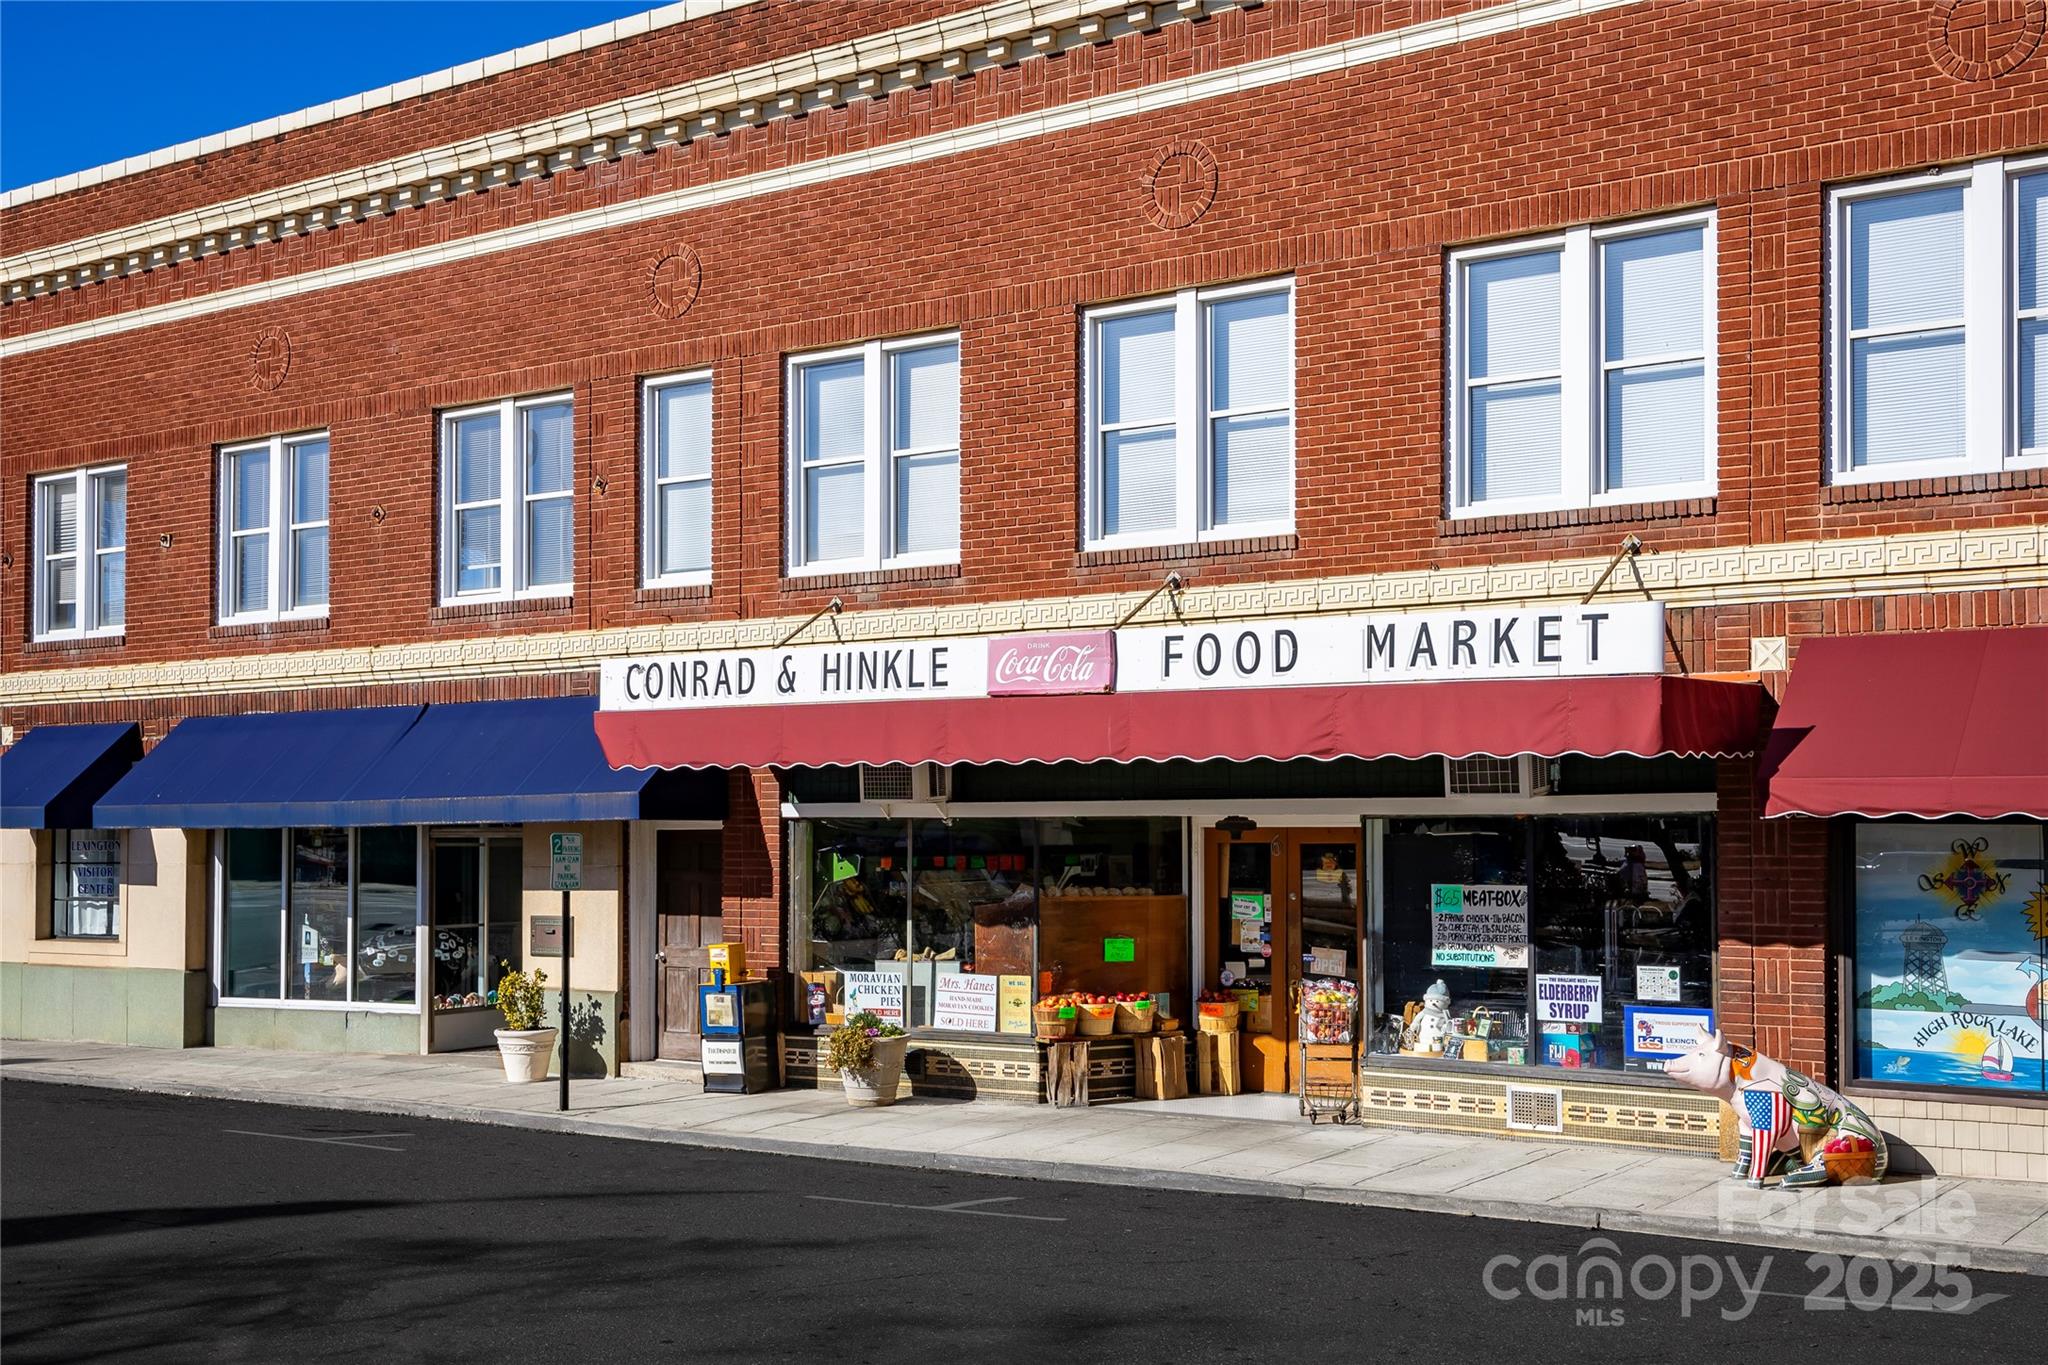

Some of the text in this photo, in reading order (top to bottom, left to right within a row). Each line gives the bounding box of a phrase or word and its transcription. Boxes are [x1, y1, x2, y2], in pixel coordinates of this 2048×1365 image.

[1162, 612, 1610, 681] FOOD MARKET
[625, 646, 950, 702] CONRAD & HINKLE
[71, 840, 121, 852] LEXINGTON
[554, 838, 561, 853] 2
[77, 867, 114, 878] VISITOR
[78, 883, 113, 894] CENTER
[1434, 887, 1521, 908] $65 MEAT-BOX
[1502, 913, 1526, 924] BACON
[1491, 924, 1522, 934] SAUSAGE
[1436, 952, 1495, 962] NO SUBSTITUTIONS
[1314, 958, 1344, 974] OPEN
[850, 972, 900, 983] MORAVIAN
[858, 985, 900, 995] CHICKEN
[939, 976, 961, 990] Mrs.
[964, 978, 994, 992] Hanes
[1538, 983, 1599, 1002] ELDERBERRY
[880, 996, 902, 1007] PIES
[938, 1002, 994, 1012] MORAVIAN COOKIES
[1549, 1002, 1590, 1020] SYRUP
[940, 1016, 990, 1029] SOLD HERE
[1913, 1011, 2039, 1053] HIGH ROCK LAKE
[1666, 1037, 1698, 1046] LEXINGT
[1549, 1044, 1566, 1059] FIJI
